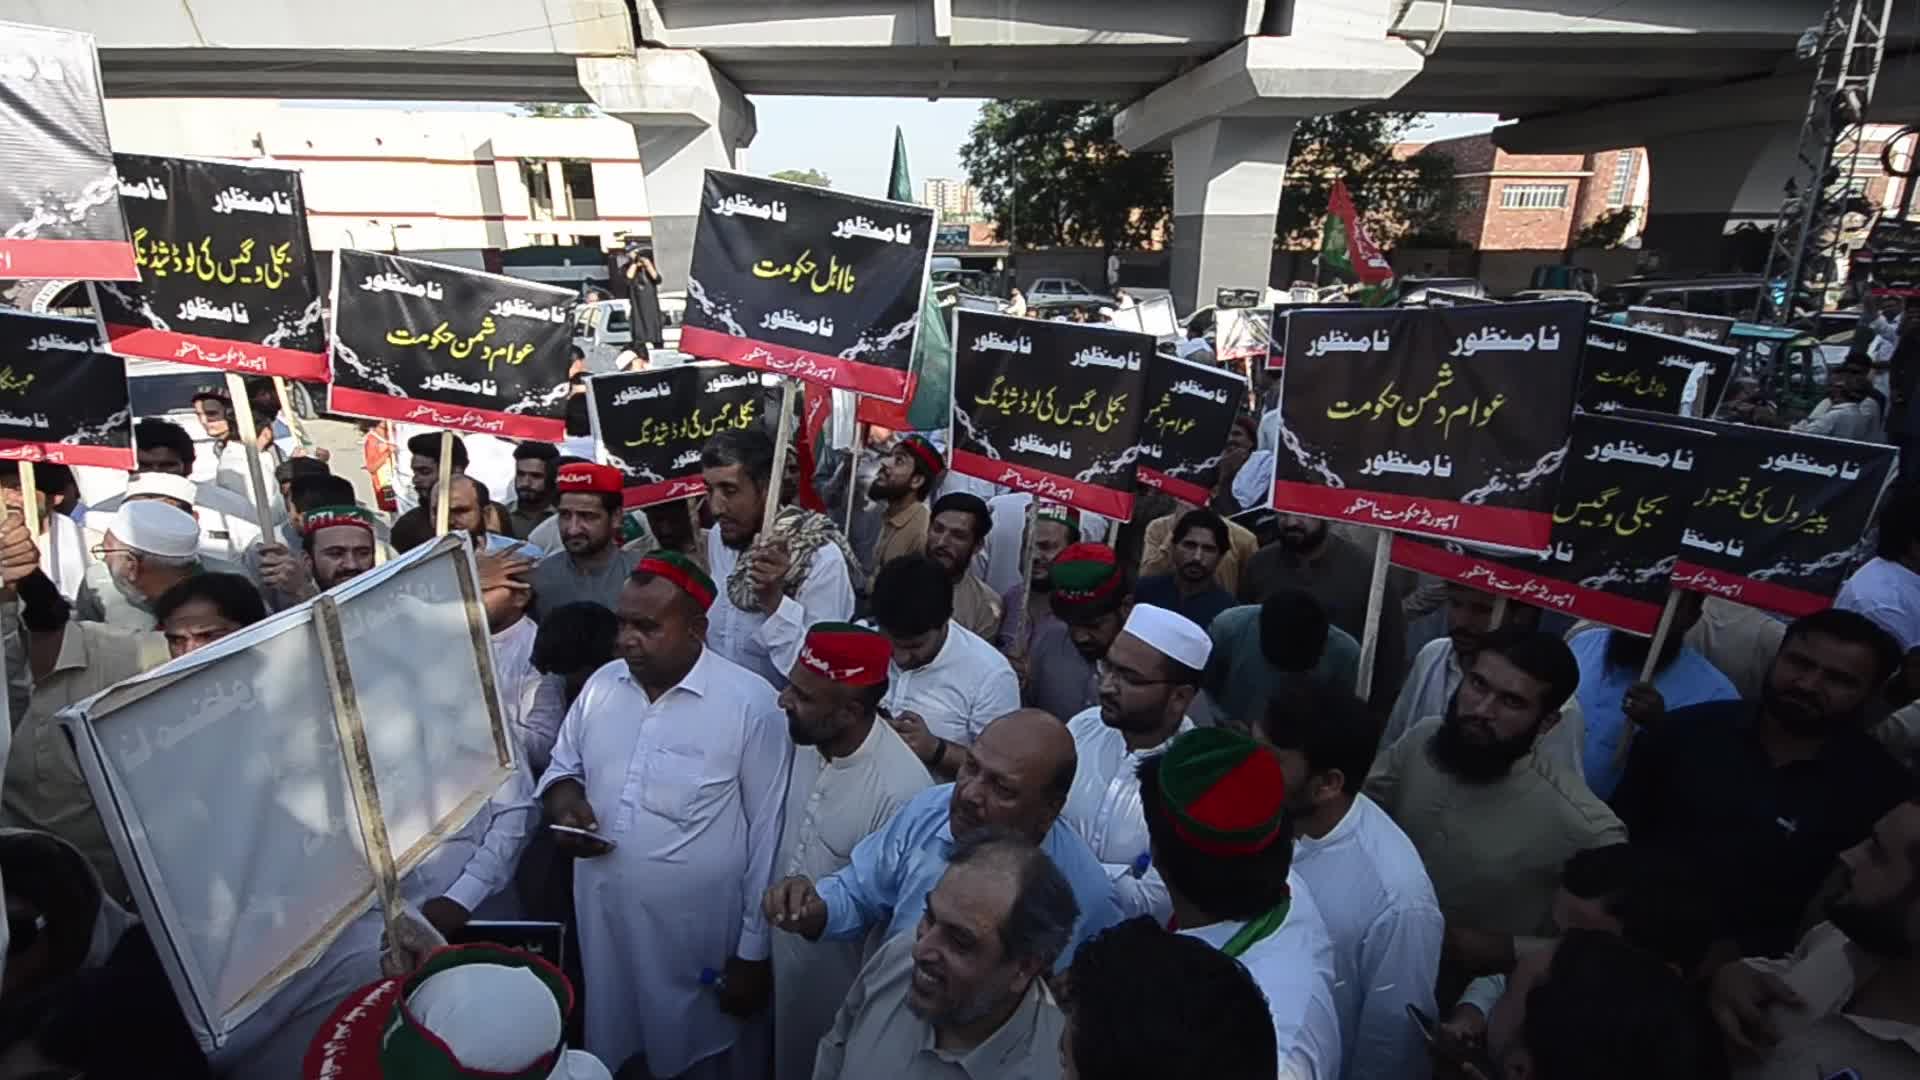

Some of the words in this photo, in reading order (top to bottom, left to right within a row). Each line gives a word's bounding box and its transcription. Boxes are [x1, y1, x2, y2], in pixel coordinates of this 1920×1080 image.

[752, 250, 816, 284] حکومت
[387, 322, 454, 350] حکومت
[1305, 330, 1390, 356] نامنظور
[1450, 325, 1560, 356] نامنظور
[1326, 381, 1402, 421] حکومت
[1360, 452, 1452, 477] نامنظور
[1585, 440, 1695, 471] نامنظور
[1760, 451, 1862, 480] نامنظور
